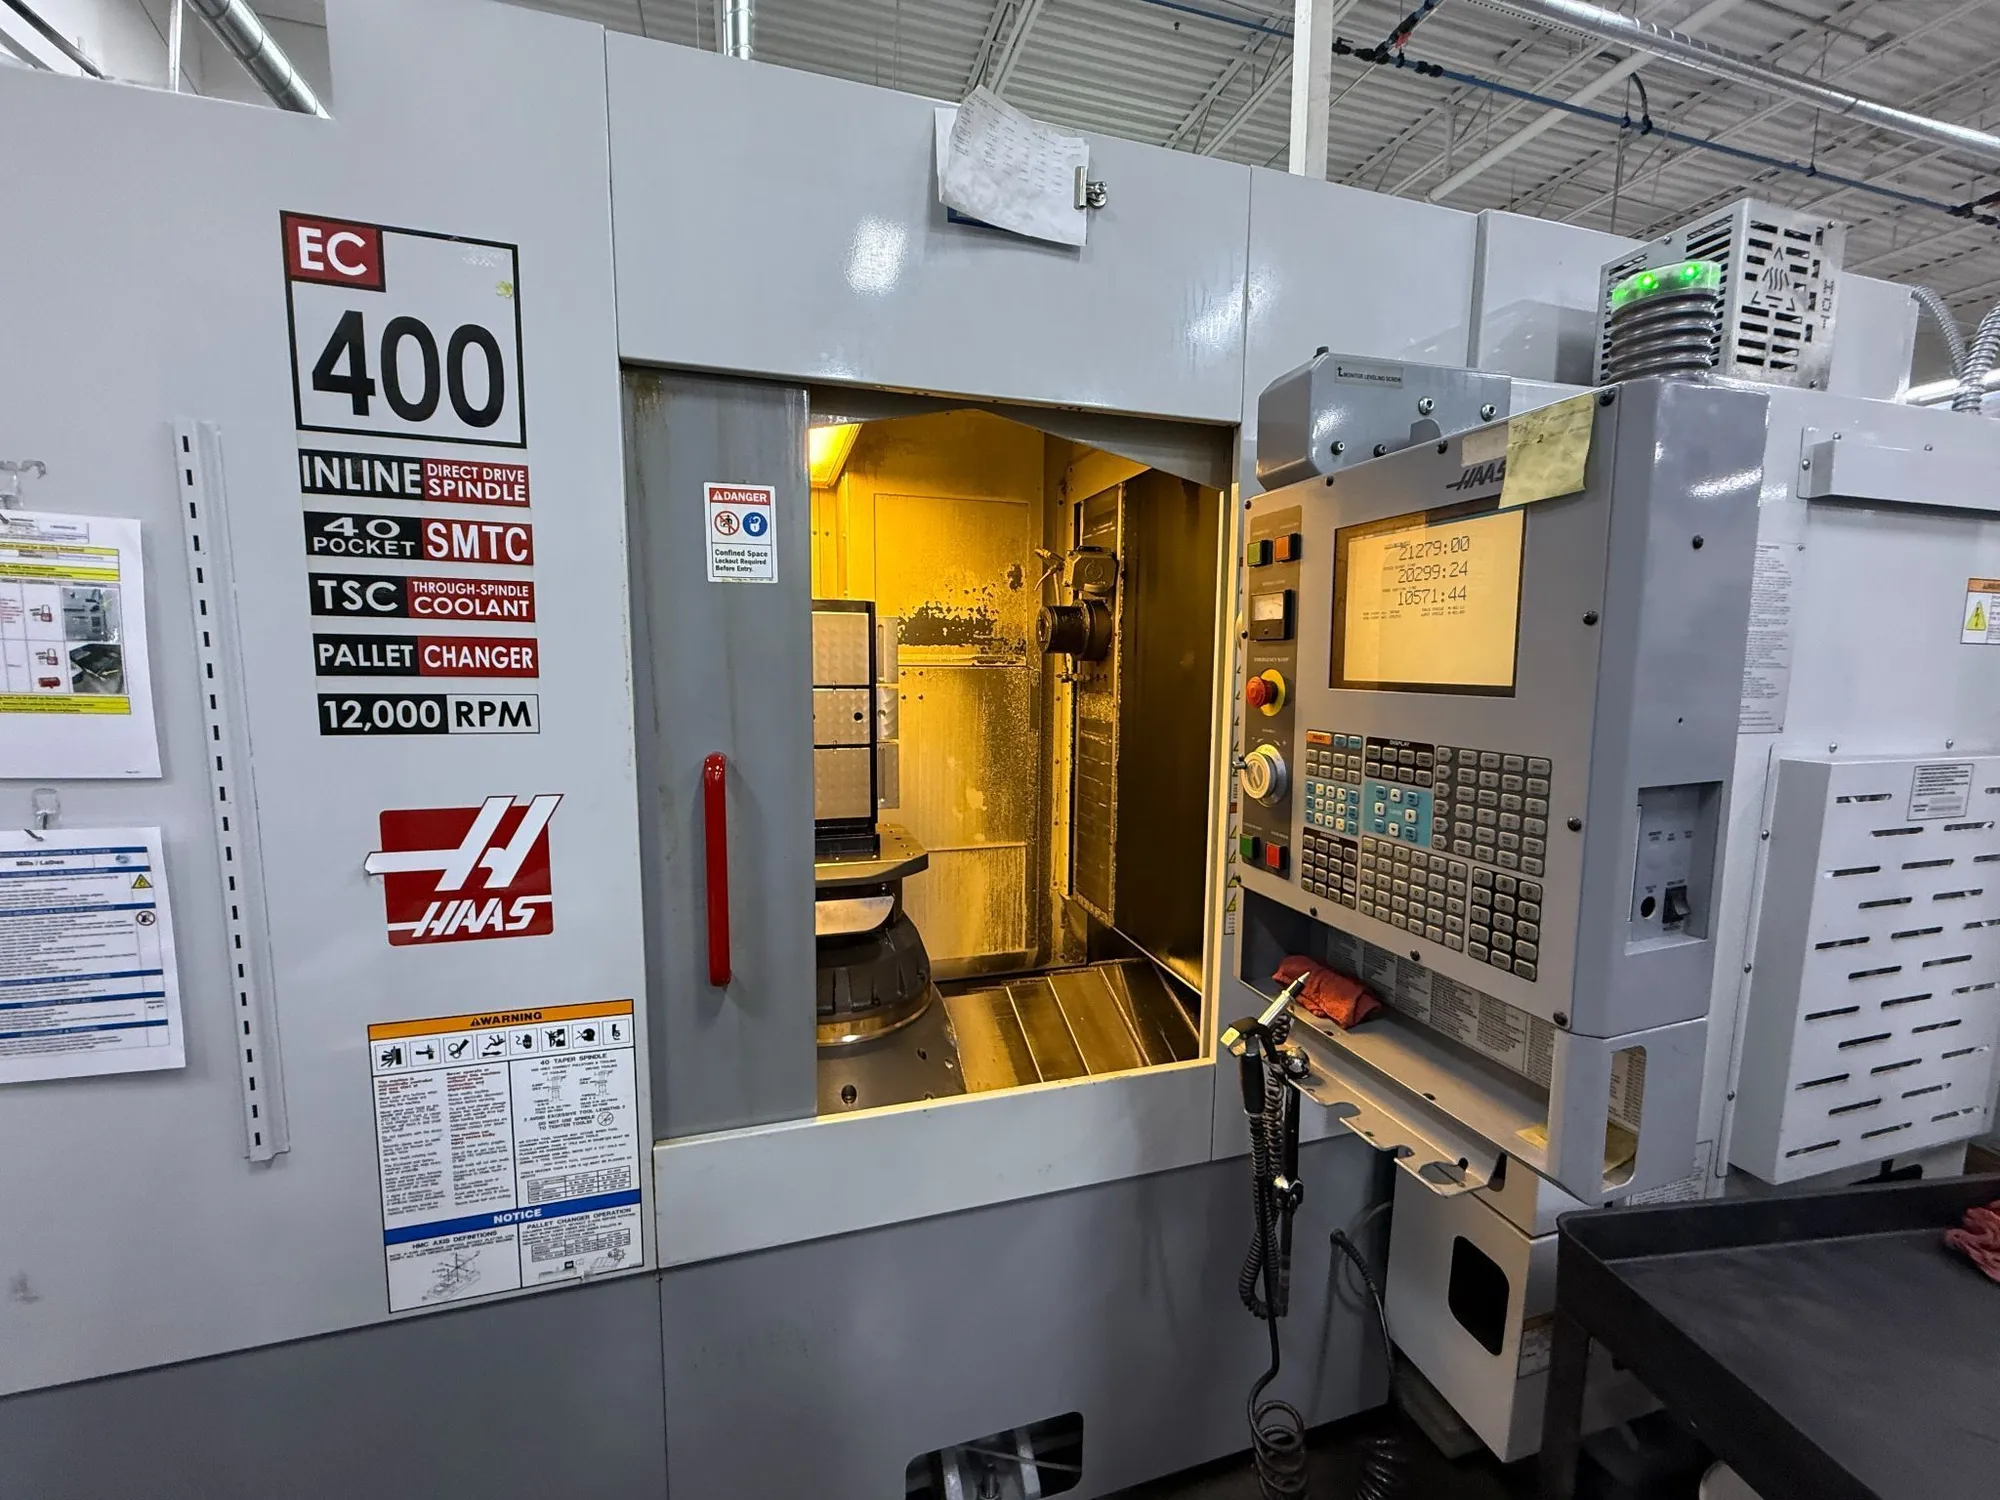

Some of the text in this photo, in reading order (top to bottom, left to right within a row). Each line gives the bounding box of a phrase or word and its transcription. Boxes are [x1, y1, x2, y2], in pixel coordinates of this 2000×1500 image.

[298, 226, 367, 276] EC
[312, 310, 505, 428] 400
[301, 455, 421, 494] INLINE
[427, 463, 525, 482] DIRECT DRIVE
[428, 478, 526, 501] SPINDLE
[723, 492, 767, 502] DANGER
[323, 516, 400, 538] 40
[313, 536, 415, 556] POCKET
[427, 522, 528, 562] SMTC
[1399, 536, 1470, 561] 21279:00
[715, 548, 768, 558] Confined Space
[740, 558, 767, 566] Required
[737, 565, 754, 573] Entry.
[1398, 560, 1469, 583] 20299:24
[317, 579, 398, 611] TSC
[412, 581, 529, 597] THROUGH-SPINDLE
[1398, 585, 1467, 606] 10571:44
[414, 596, 530, 617] COOLANT
[318, 643, 533, 669] PALLET CHANGER
[323, 700, 532, 732] 12,000 RPM
[388, 895, 552, 938] HAAS
[1524, 907, 1531, 915] 6
[480, 1011, 543, 1026] WARNING
[554, 1056, 576, 1064] TAPER
[579, 1053, 607, 1061] SPINDLE
[493, 1208, 542, 1224] NOTICE
[526, 1207, 632, 1229] PALLET CHANGER OPERATION
[412, 1230, 497, 1249] HMC AXIS DEFINITIONS
